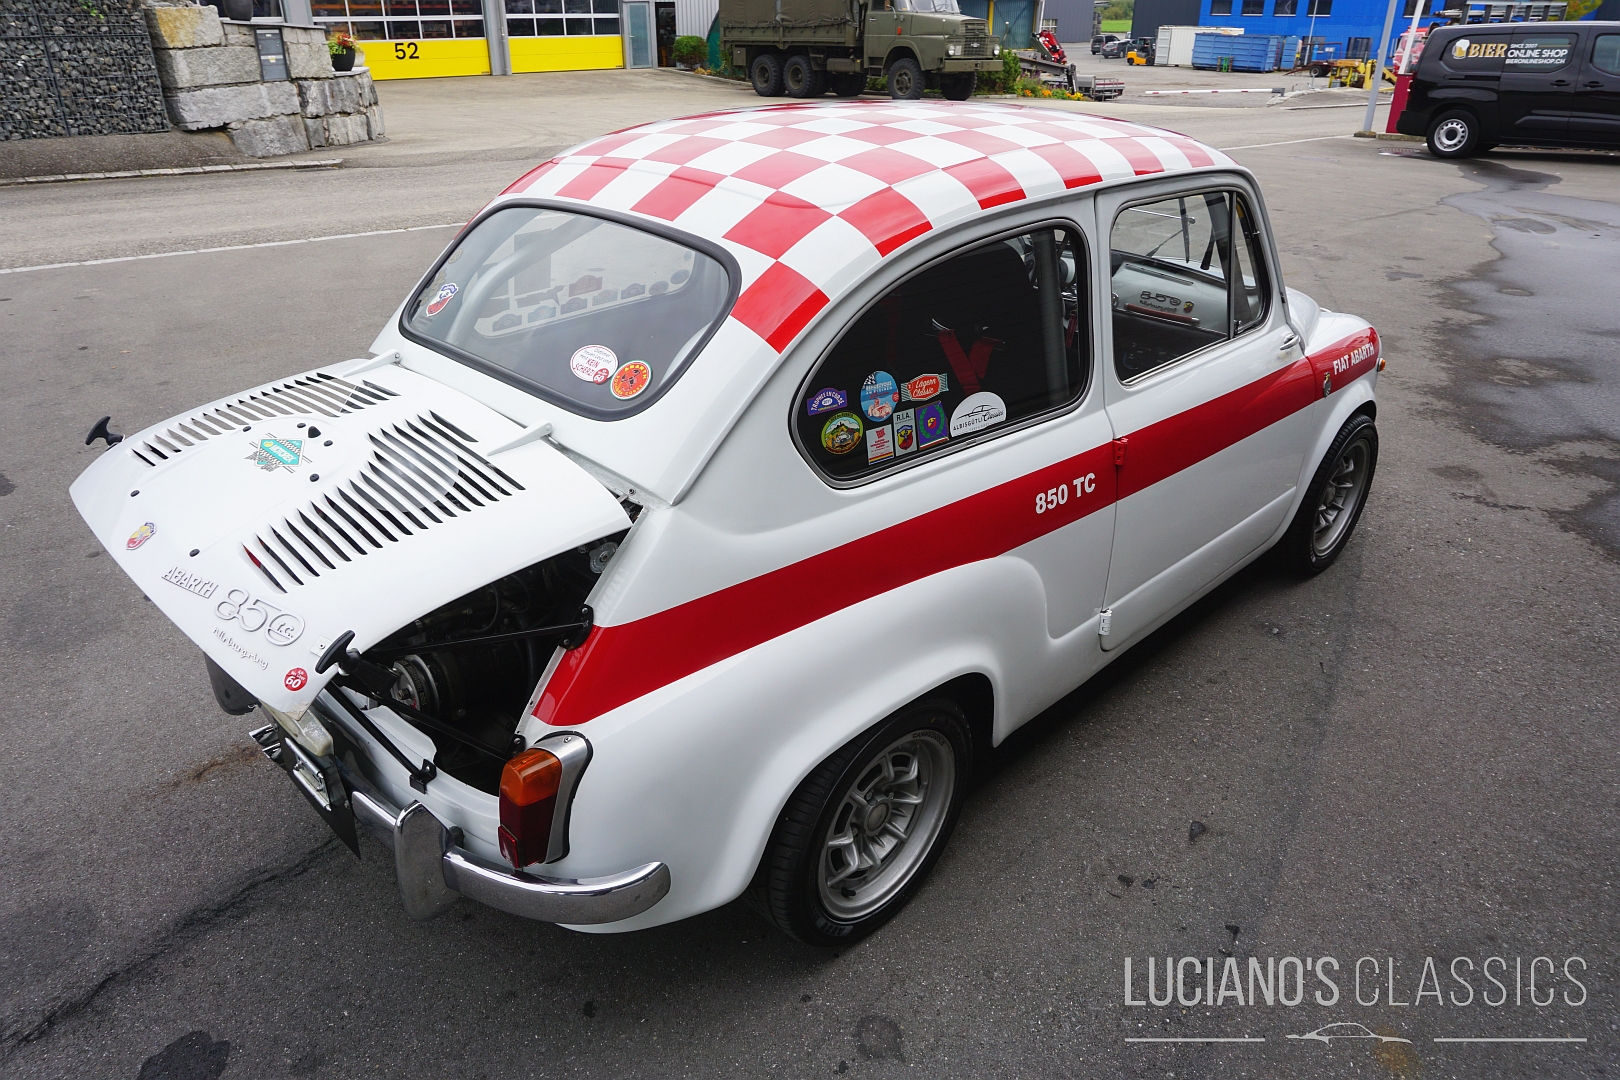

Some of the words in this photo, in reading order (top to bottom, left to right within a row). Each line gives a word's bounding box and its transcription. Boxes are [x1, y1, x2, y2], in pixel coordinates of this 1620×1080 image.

[394, 42, 420, 60] 52
[1467, 43, 1508, 58] BIER
[1507, 49, 1541, 58] ONLINE
[1541, 49, 1568, 58] SHOP
[1140, 290, 1182, 306] 850
[586, 358, 601, 369] KEIN
[1332, 354, 1350, 376] FIAT
[1350, 341, 1375, 366] ABARTH
[594, 374, 605, 382] 60
[624, 364, 647, 380] ABARTH
[896, 412, 912, 422] R.I.A.
[1035, 483, 1069, 515] 850
[1072, 472, 1096, 498] TC
[162, 566, 219, 599] ABARTH
[214, 587, 306, 647] 850
[285, 675, 302, 689] 60
